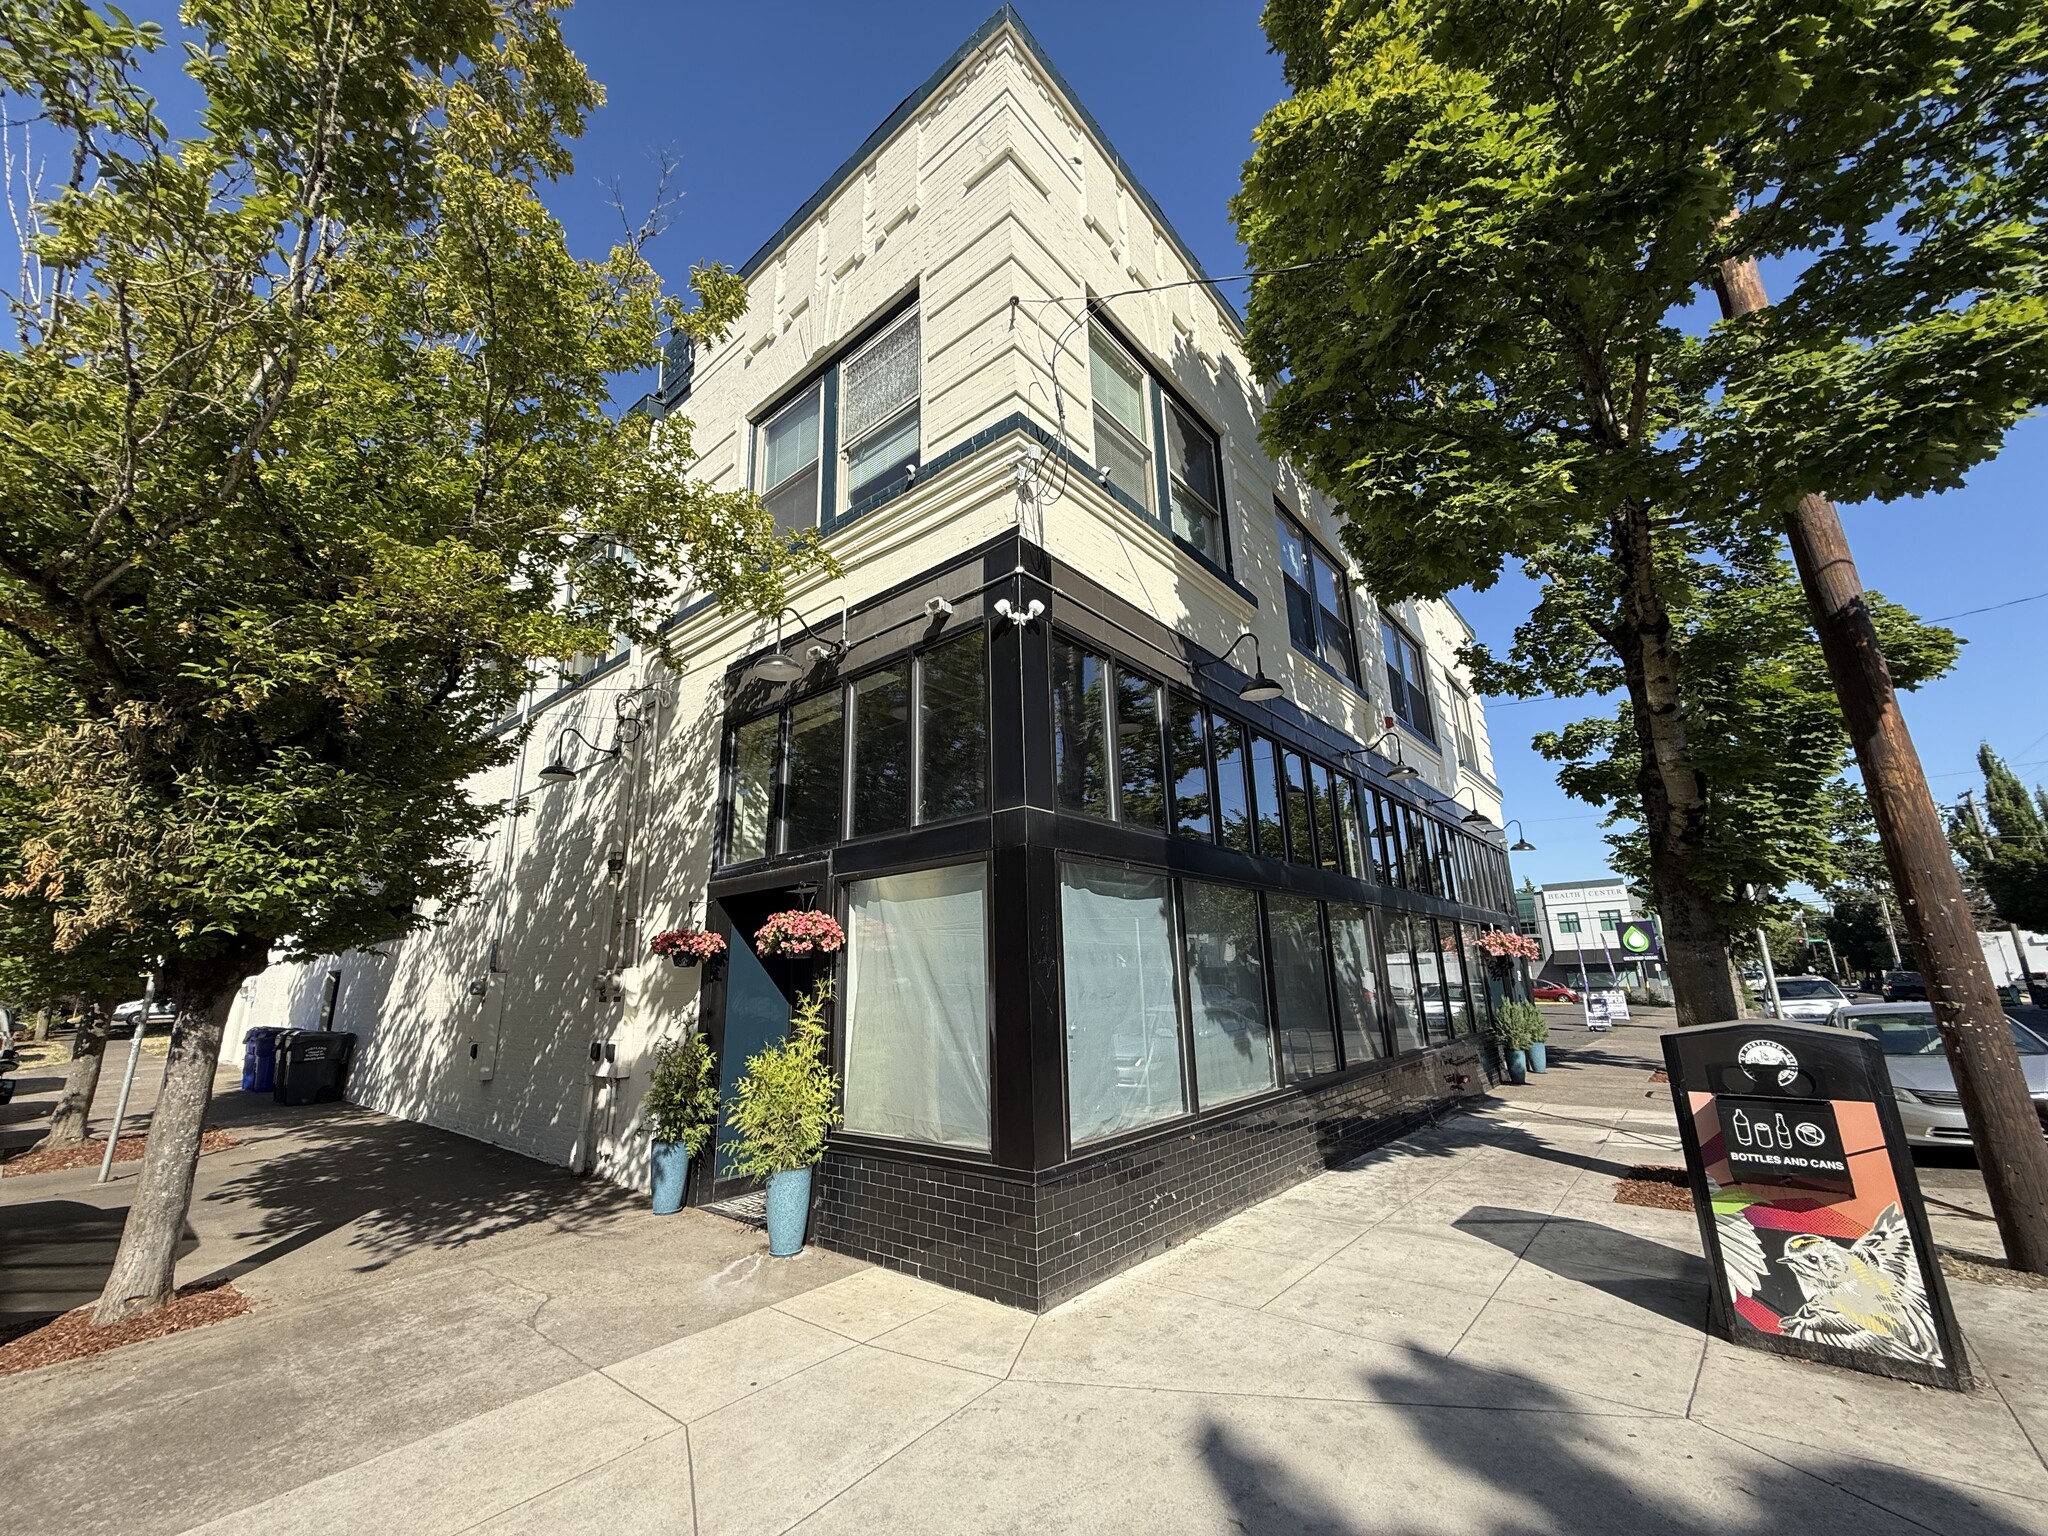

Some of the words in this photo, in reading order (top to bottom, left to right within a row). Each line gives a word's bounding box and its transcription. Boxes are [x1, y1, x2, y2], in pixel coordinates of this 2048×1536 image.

[1548, 891, 1581, 900] HEALTH
[1588, 888, 1623, 897] CENTER
[1730, 1152, 1781, 1164] BOTTLES
[1783, 1157, 1808, 1167] AND
[1810, 1159, 1845, 1170] CANS
